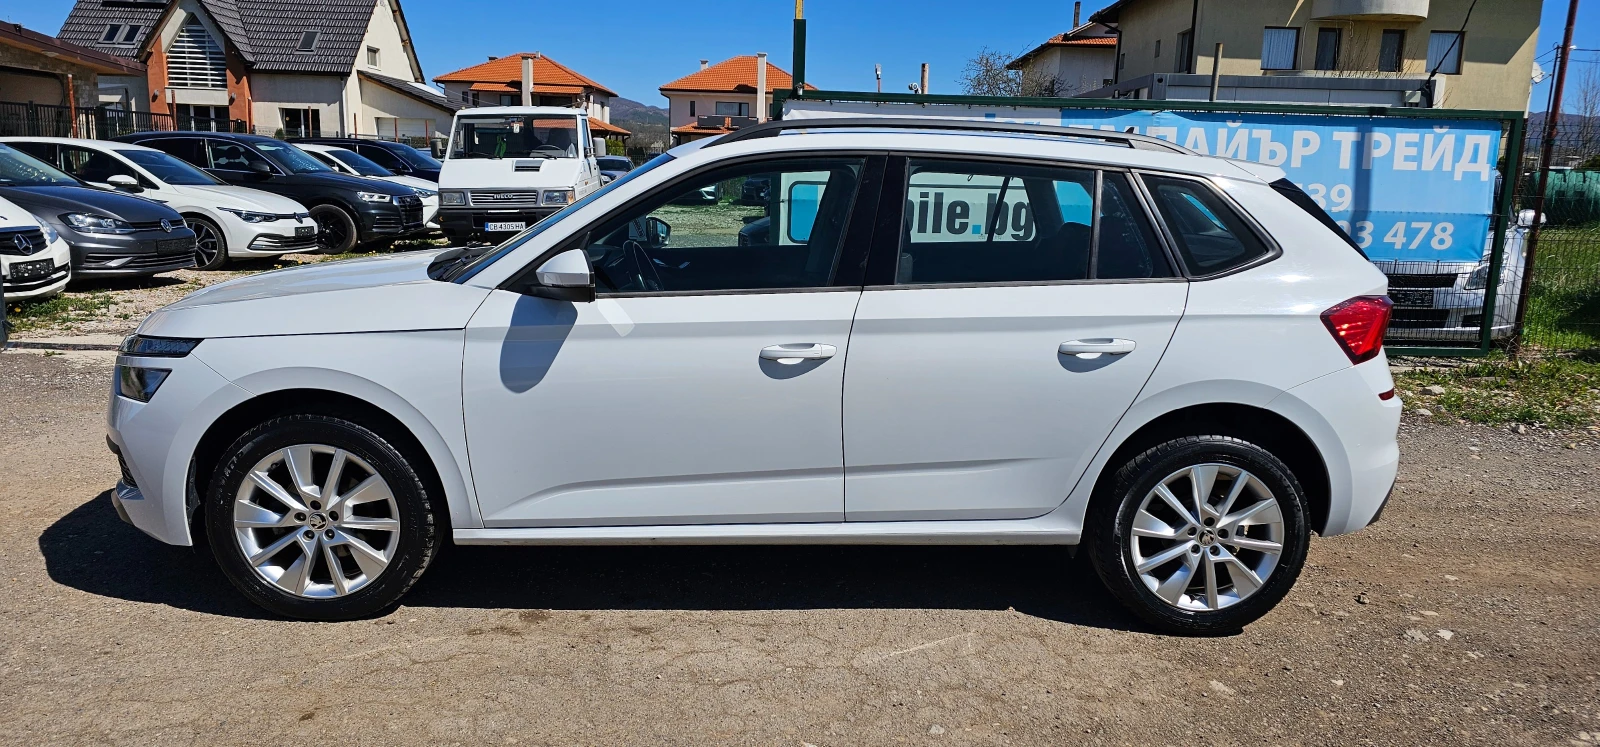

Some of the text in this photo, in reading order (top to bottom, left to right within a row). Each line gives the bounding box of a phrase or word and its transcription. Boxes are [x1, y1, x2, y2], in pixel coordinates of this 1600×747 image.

[1333, 125, 1490, 181] ТРЕЙД
[1294, 183, 1353, 212] 39
[1384, 221, 1454, 250] 478
